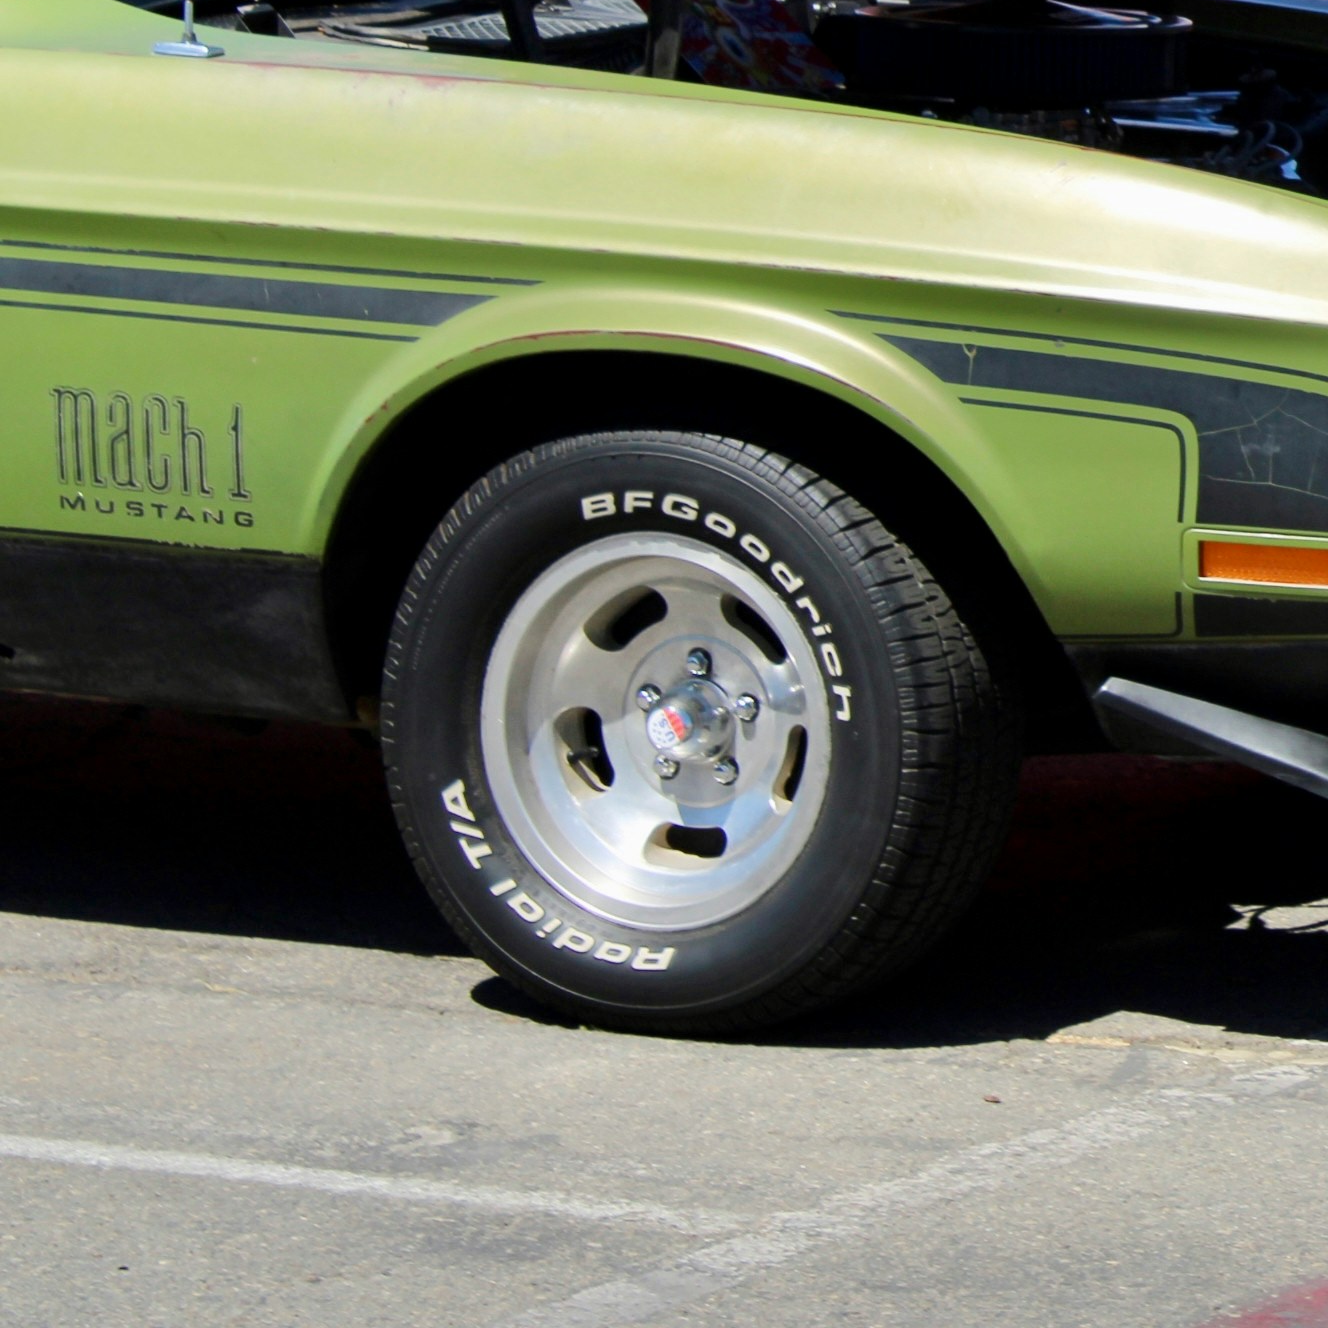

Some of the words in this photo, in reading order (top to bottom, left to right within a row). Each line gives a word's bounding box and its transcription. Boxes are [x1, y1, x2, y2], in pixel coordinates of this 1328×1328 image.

[226, 402, 252, 502] 1
[59, 492, 255, 528] MUSTANG
[580, 490, 853, 723] BFGoodrich
[441, 779, 493, 870] T/A
[489, 878, 676, 971] Radial
